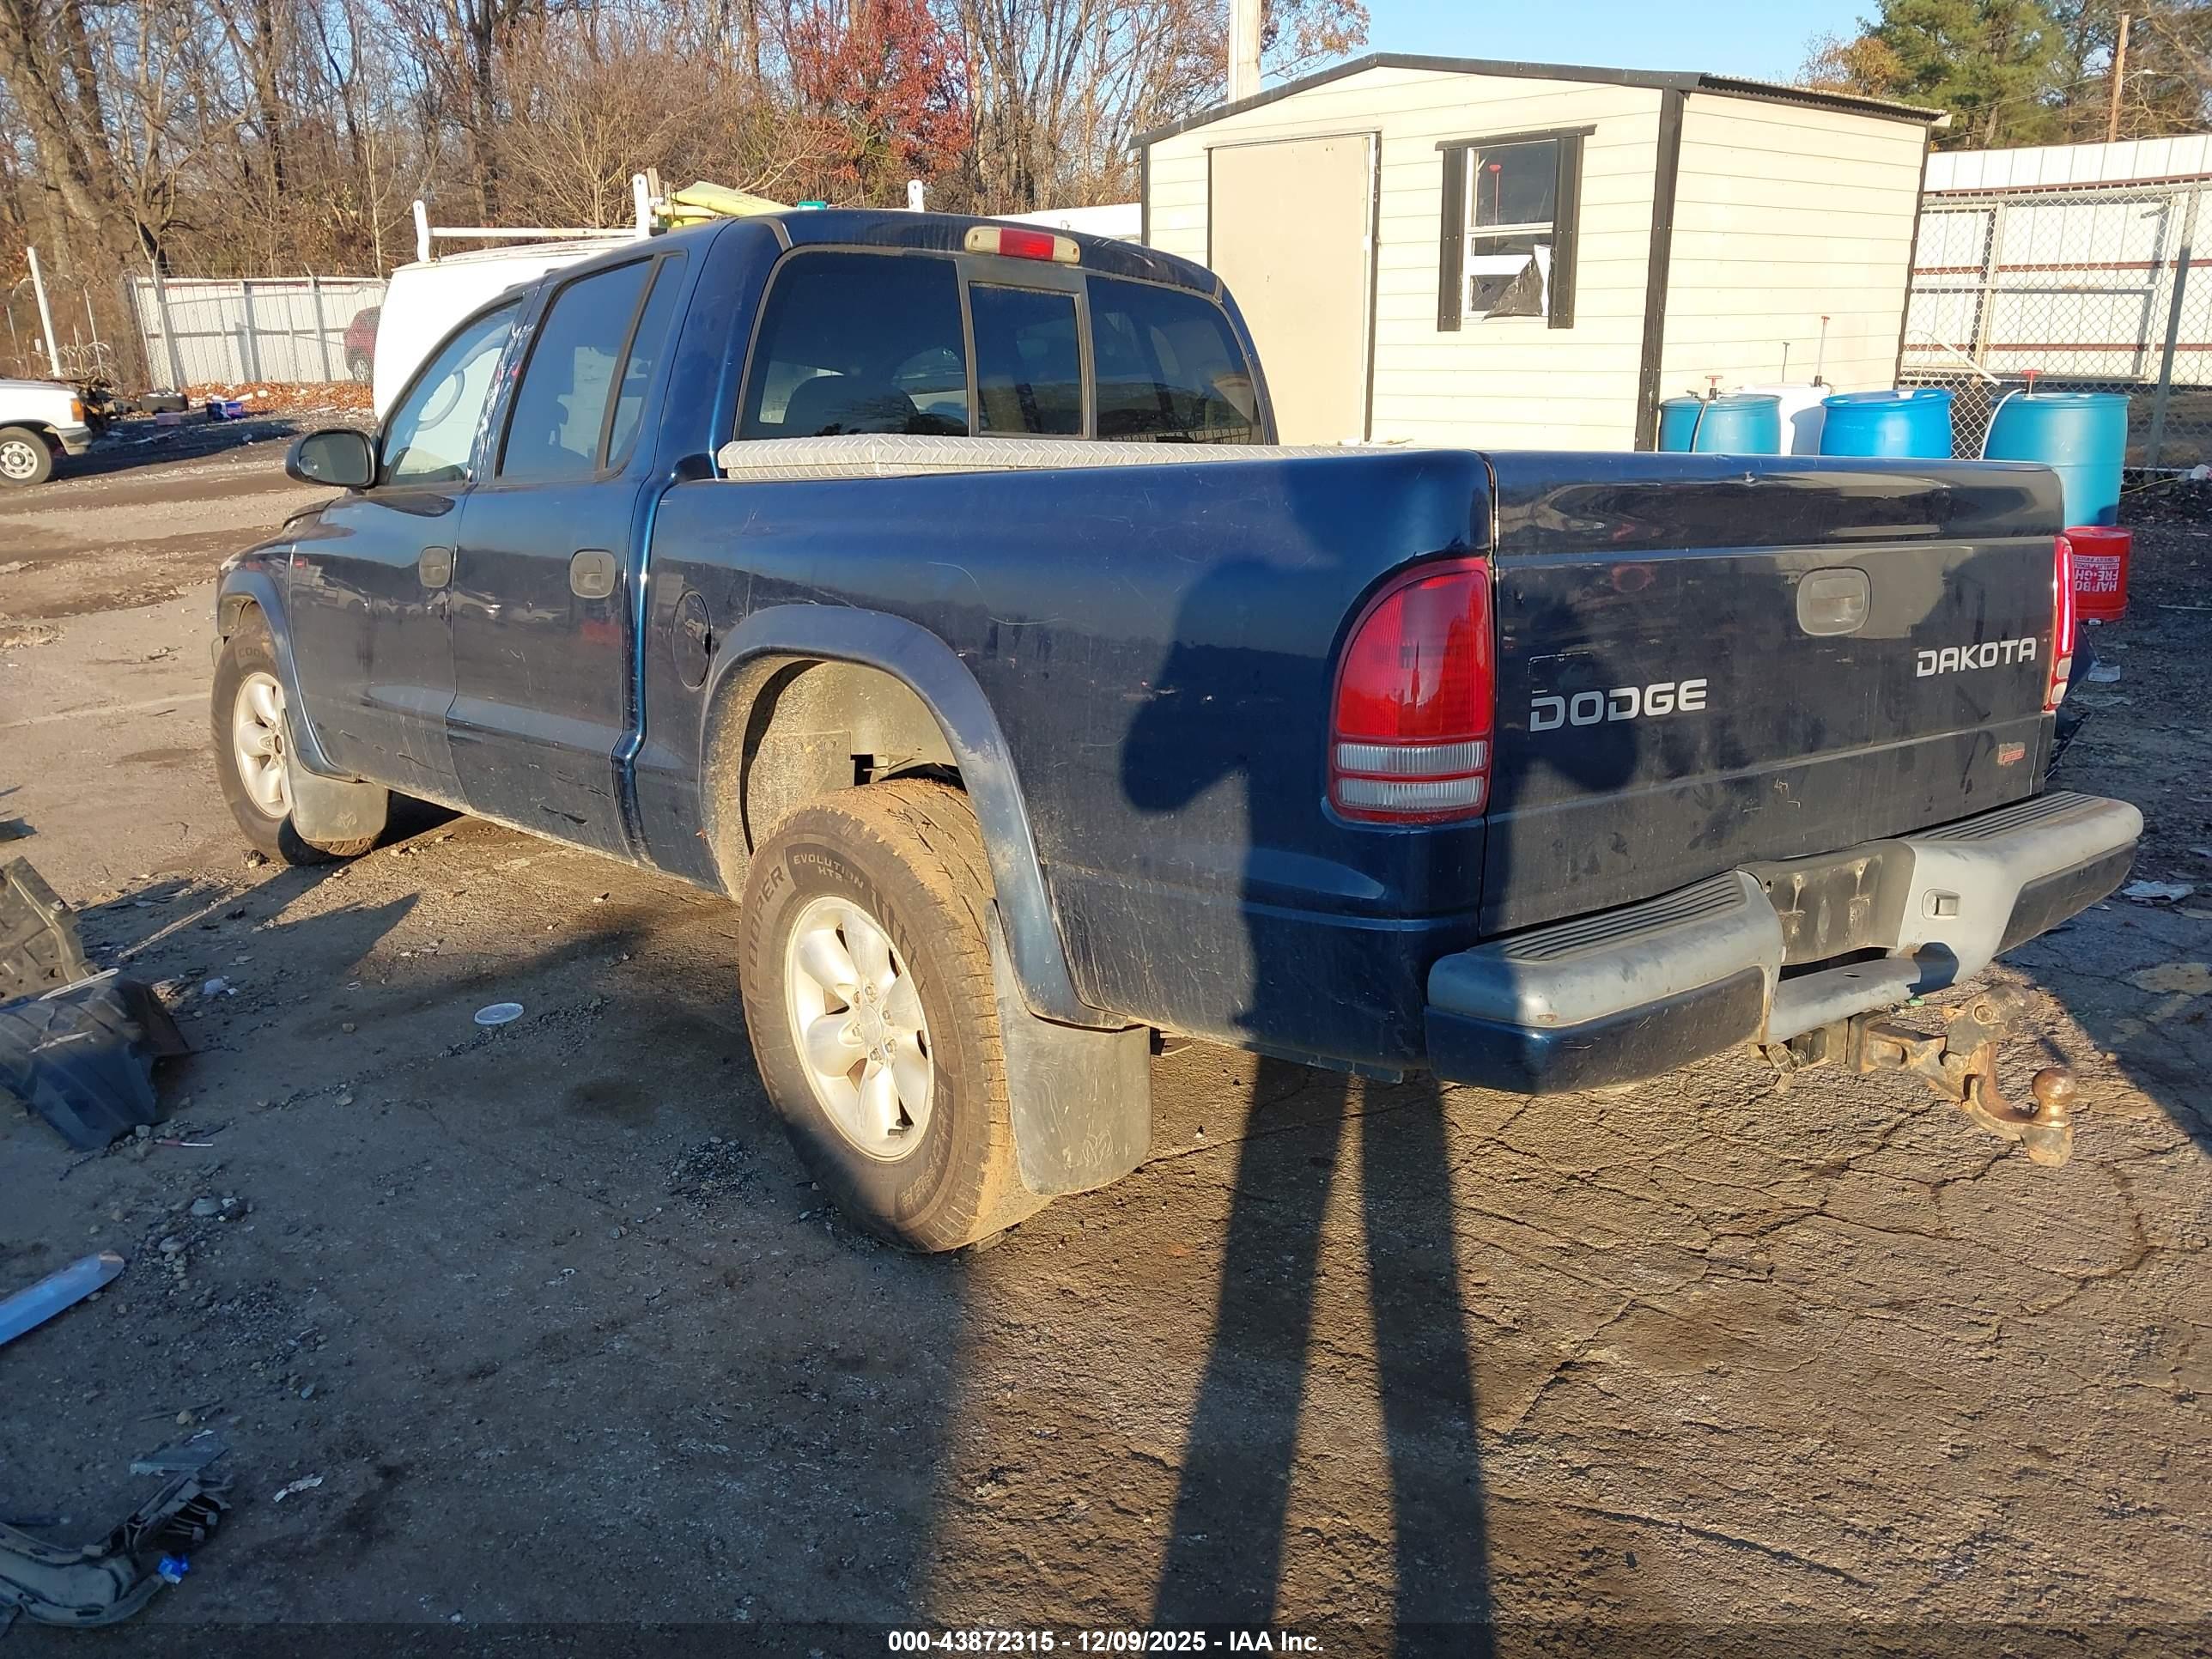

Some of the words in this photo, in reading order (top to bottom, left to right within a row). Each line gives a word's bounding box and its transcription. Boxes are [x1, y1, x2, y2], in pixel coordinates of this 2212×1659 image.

[1917, 637, 2037, 678] DAKOTA
[1530, 678, 1707, 732] DODGE
[793, 853, 864, 890] EVOLUTION
[749, 866, 785, 991] COOPER
